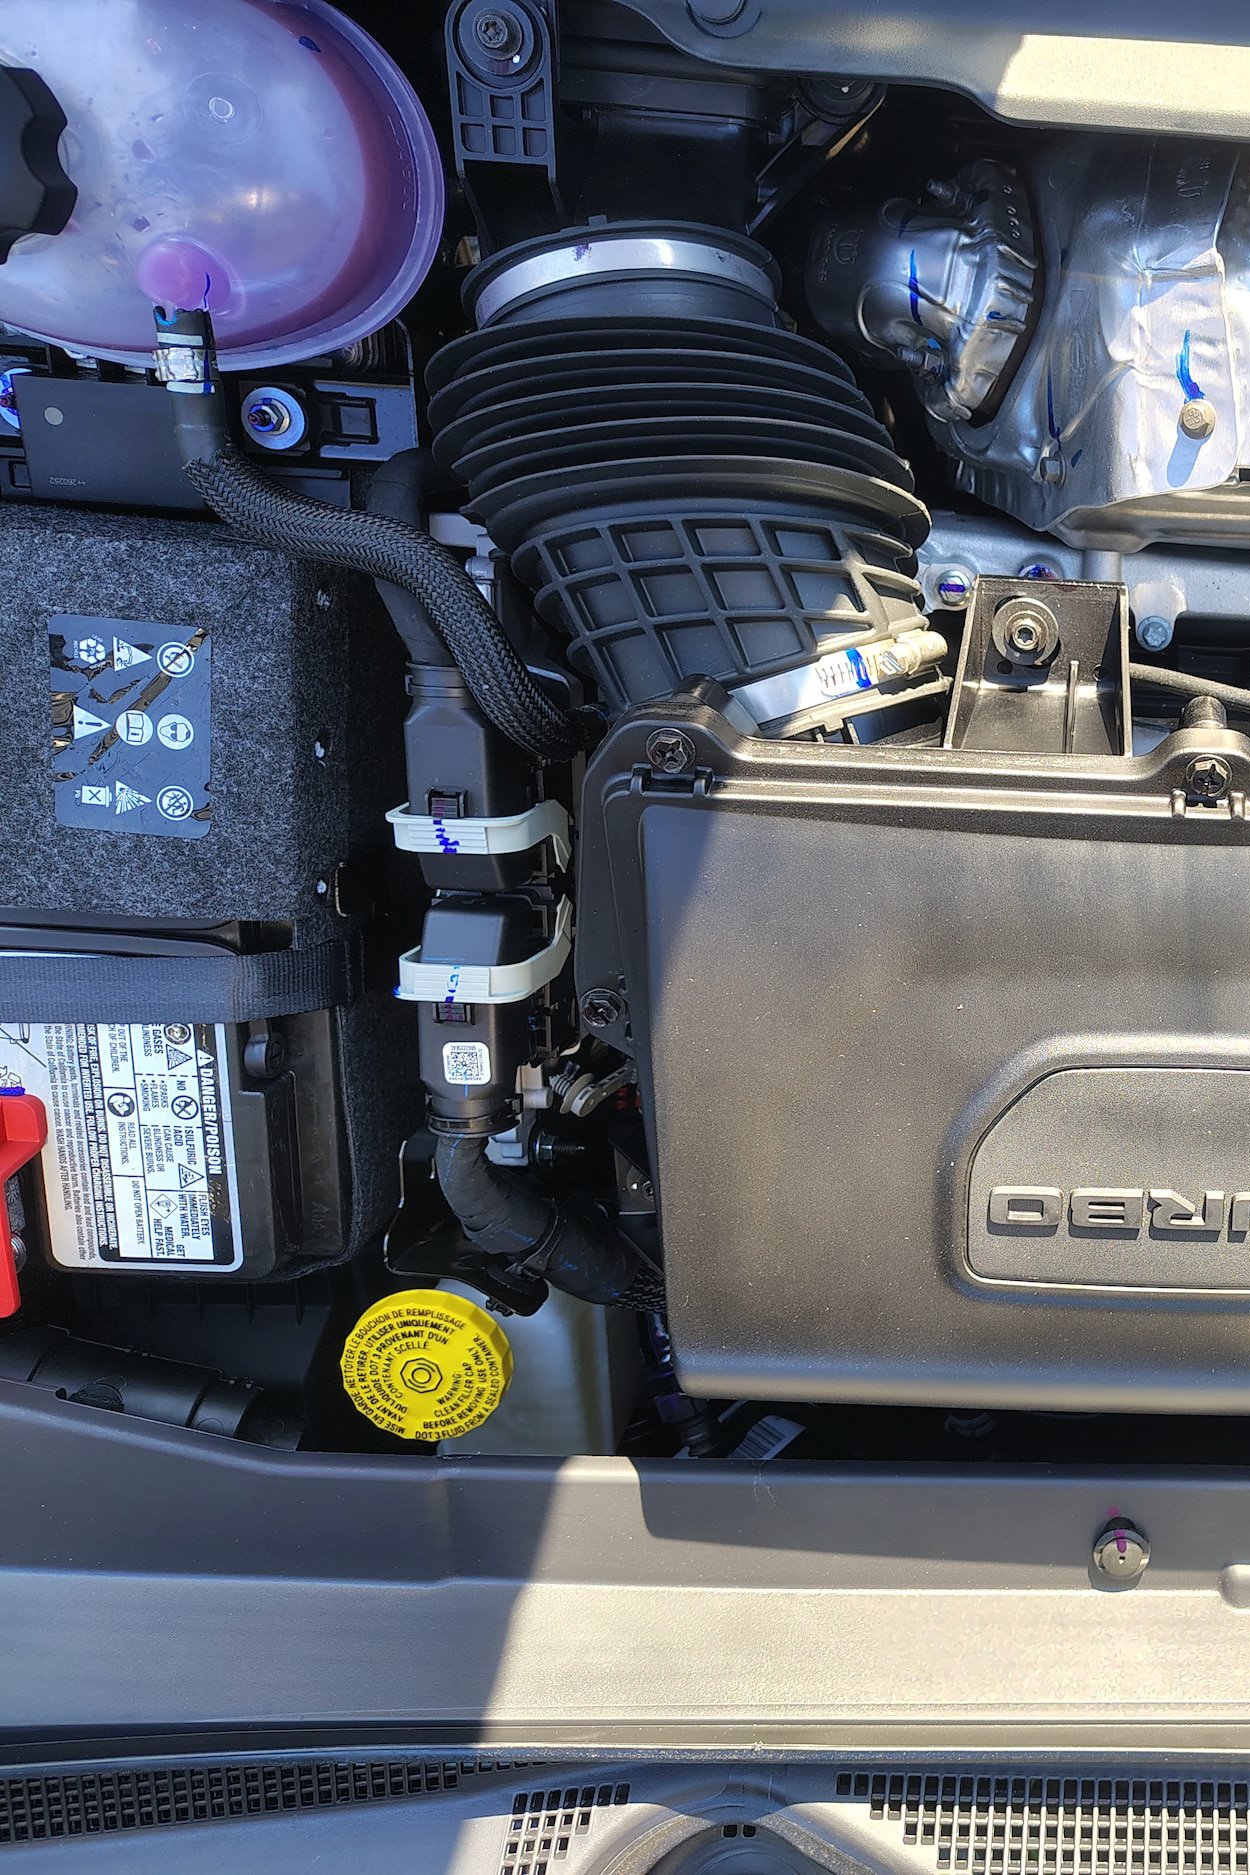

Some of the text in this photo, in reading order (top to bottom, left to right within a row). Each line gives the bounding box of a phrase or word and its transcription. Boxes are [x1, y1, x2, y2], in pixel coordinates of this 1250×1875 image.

[44, 1025, 54, 1034] the
[54, 1025, 64, 1034] the
[110, 1033, 118, 1041] OF
[118, 1029, 127, 1040] OUT
[45, 1035, 55, 1049] State
[55, 1036, 66, 1049] State
[153, 1029, 163, 1053] GASES
[66, 1045, 78, 1063] Battery
[80, 1054, 89, 1067] FOR
[110, 1042, 120, 1073] CHILDREN.
[120, 1051, 128, 1062] THE
[47, 1057, 59, 1083] California
[57, 1058, 69, 1083] California
[68, 1066, 79, 1081] posts,
[81, 1068, 92, 1098] INVERTED
[176, 1081, 186, 1091] NO
[51, 1091, 61, 1106] cause
[61, 1092, 71, 1107] cause
[70, 1083, 82, 1107] terminals
[140, 1083, 151, 1112] SMOKING
[150, 1084, 160, 1108] FLAMES
[159, 1084, 169, 1108] SPARKS
[72, 1109, 83, 1119] and
[84, 1100, 94, 1114] USE.
[52, 1108, 63, 1127] cancer.
[62, 1108, 73, 1126] cancer
[199, 1068, 222, 1174] DANGER/POISON
[54, 1129, 65, 1144] WASH
[64, 1128, 74, 1137] and
[74, 1120, 85, 1138] related
[86, 1116, 96, 1140] FOLLOW
[86, 1024, 117, 1249] ISK OF FIRE, EXPLOSION OR BURNS. DO NOT DISASSEMBLE OR INCINERATE.
[128, 1122, 137, 1149] READ ALL
[117, 1121, 130, 1165] INSTRUCTIONS.
[164, 1129, 173, 1162] CAN CAUSE
[173, 1129, 183, 1147] ACID
[184, 1130, 197, 1165] SULFURIC
[56, 1145, 67, 1164] HANDS
[66, 1139, 77, 1172] reproductive
[75, 1140, 88, 1170] accessories
[88, 1142, 99, 1166] PROPER
[144, 1128, 154, 1173] SEVERE BURNS.
[154, 1128, 164, 1171] BLINDNESS OR
[58, 1165, 68, 1181] AFTER
[69, 1173, 79, 1187] harm.
[79, 1172, 90, 1191] contain
[91, 1168, 102, 1199] CHARGING
[60, 1182, 71, 1210] HANDLING.
[71, 1190, 81, 1212] Batteries
[80, 1193, 91, 1203] lead
[133, 1189, 141, 1200] NOT
[73, 1214, 82, 1224] also
[82, 1205, 92, 1215] and
[134, 1202, 142, 1217] OPEN
[178, 1194, 190, 1238] WITH WATER.
[188, 1194, 201, 1240] IMMEDIATELY
[199, 1194, 210, 1235] FLUSH EYES
[83, 1216, 93, 1227] lead
[94, 1201, 107, 1246] INSTRUCTIONS.
[74, 1226, 84, 1245] contain
[135, 1219, 144, 1244] BATTERY.
[154, 1219, 165, 1256] HELP FAST.
[84, 1228, 96, 1260] compounds,
[164, 1227, 175, 1256] MEDICAL
[175, 1244, 186, 1257] GET
[76, 1246, 86, 1260] other
[392, 1309, 404, 1319] DE
[406, 1308, 467, 1330] REMPLISSAGE
[357, 1313, 392, 1340] BOUCHON
[366, 1324, 396, 1348] UTILISER
[396, 1319, 457, 1336] UNIQUEMENT
[351, 1338, 360, 1349] LE
[378, 1331, 424, 1353] PROVENANT
[428, 1331, 449, 1345] D'UN
[345, 1349, 356, 1387] NETTOYER
[371, 1360, 379, 1376] DOT
[384, 1351, 403, 1399] CONTENANT
[362, 1384, 371, 1393] LE
[371, 1378, 395, 1410] LIQUIDE
[423, 1346, 488, 1429] BEFORE REMOVING USE ONLY
[434, 1362, 475, 1417] CLEAN FILLER CAP
[367, 1393, 378, 1404] DE
[415, 1431, 432, 1439] DOT
[435, 1430, 441, 1438] 3
[442, 1425, 465, 1438] FLUID
[465, 1412, 485, 1427] FROM
[486, 1377, 500, 1407] SEALED
[377, 1404, 403, 1422] AVANT
[394, 1403, 408, 1414] DU
[373, 1413, 385, 1425] EN
[386, 1423, 406, 1434] MISE
